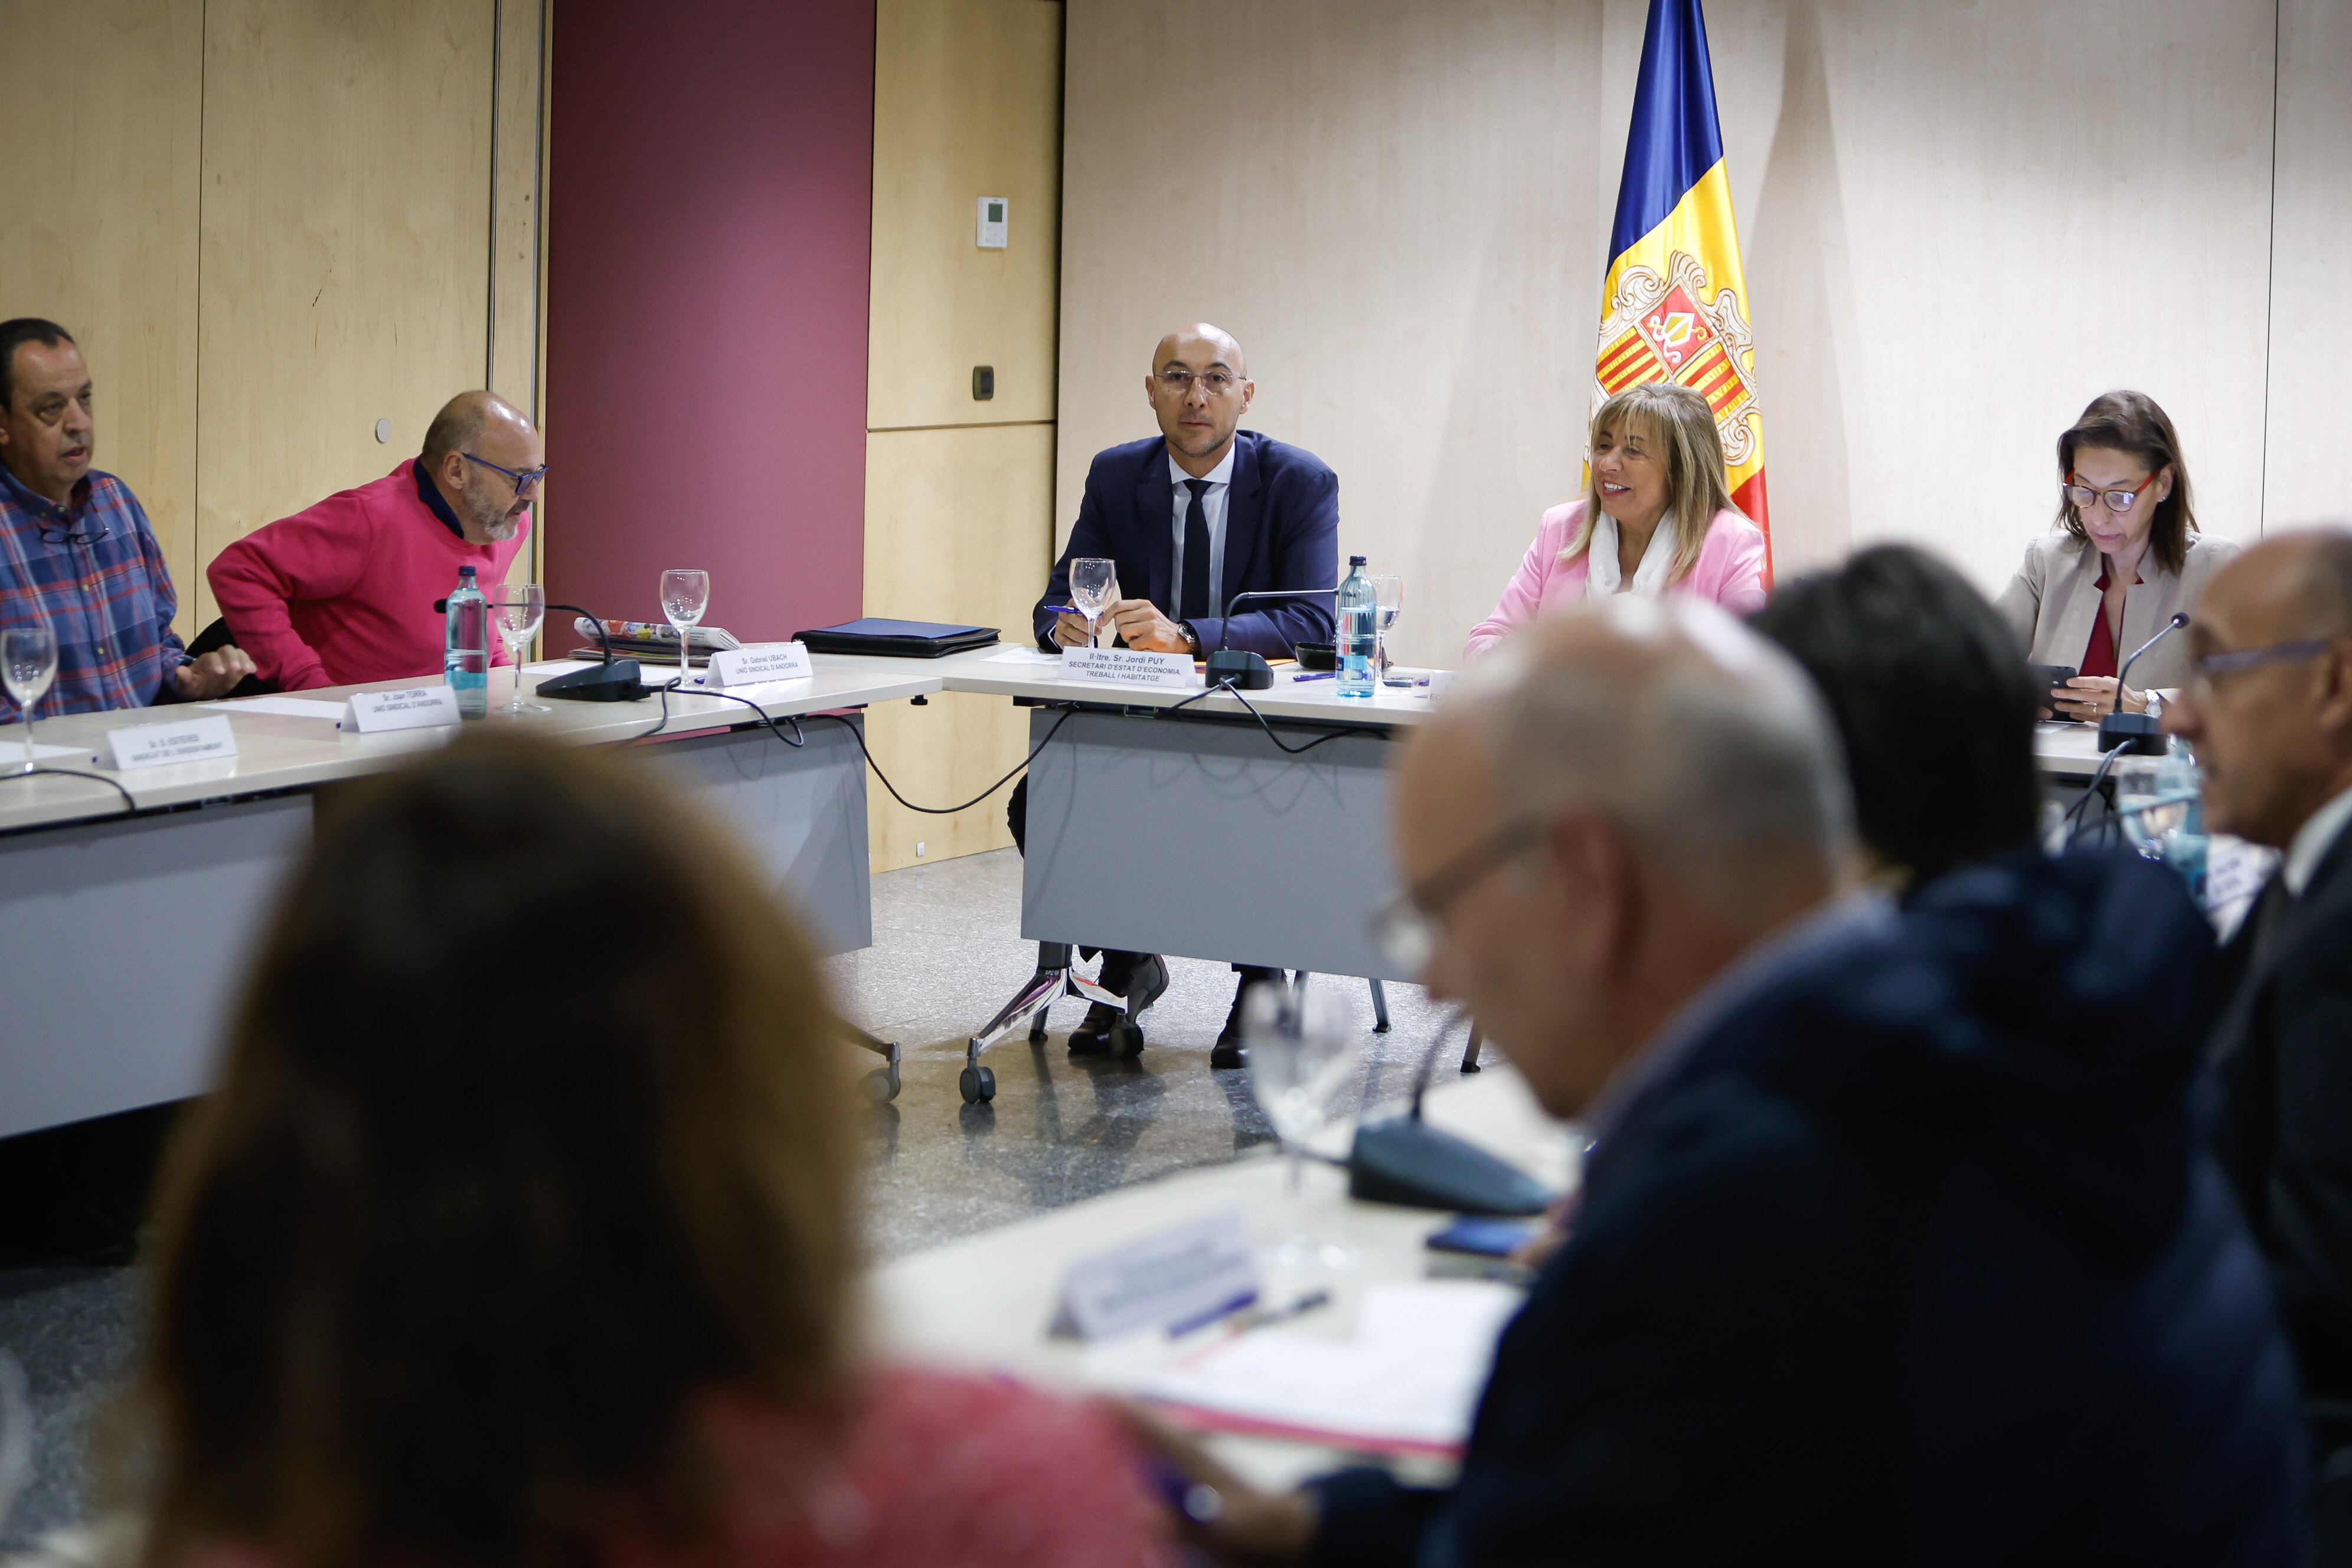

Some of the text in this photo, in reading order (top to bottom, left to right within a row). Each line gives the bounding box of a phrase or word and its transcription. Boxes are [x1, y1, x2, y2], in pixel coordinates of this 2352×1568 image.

[768, 654, 788, 662] UBACH
[1126, 655, 1146, 664] Jordi
[770, 662, 798, 671] D'ANDORRA
[1069, 661, 1106, 669] SECRETARI
[1137, 666, 1181, 675] D'ECONOMIA,
[1086, 671, 1115, 679] TREBALL
[1121, 673, 1160, 682] HABITATGE
